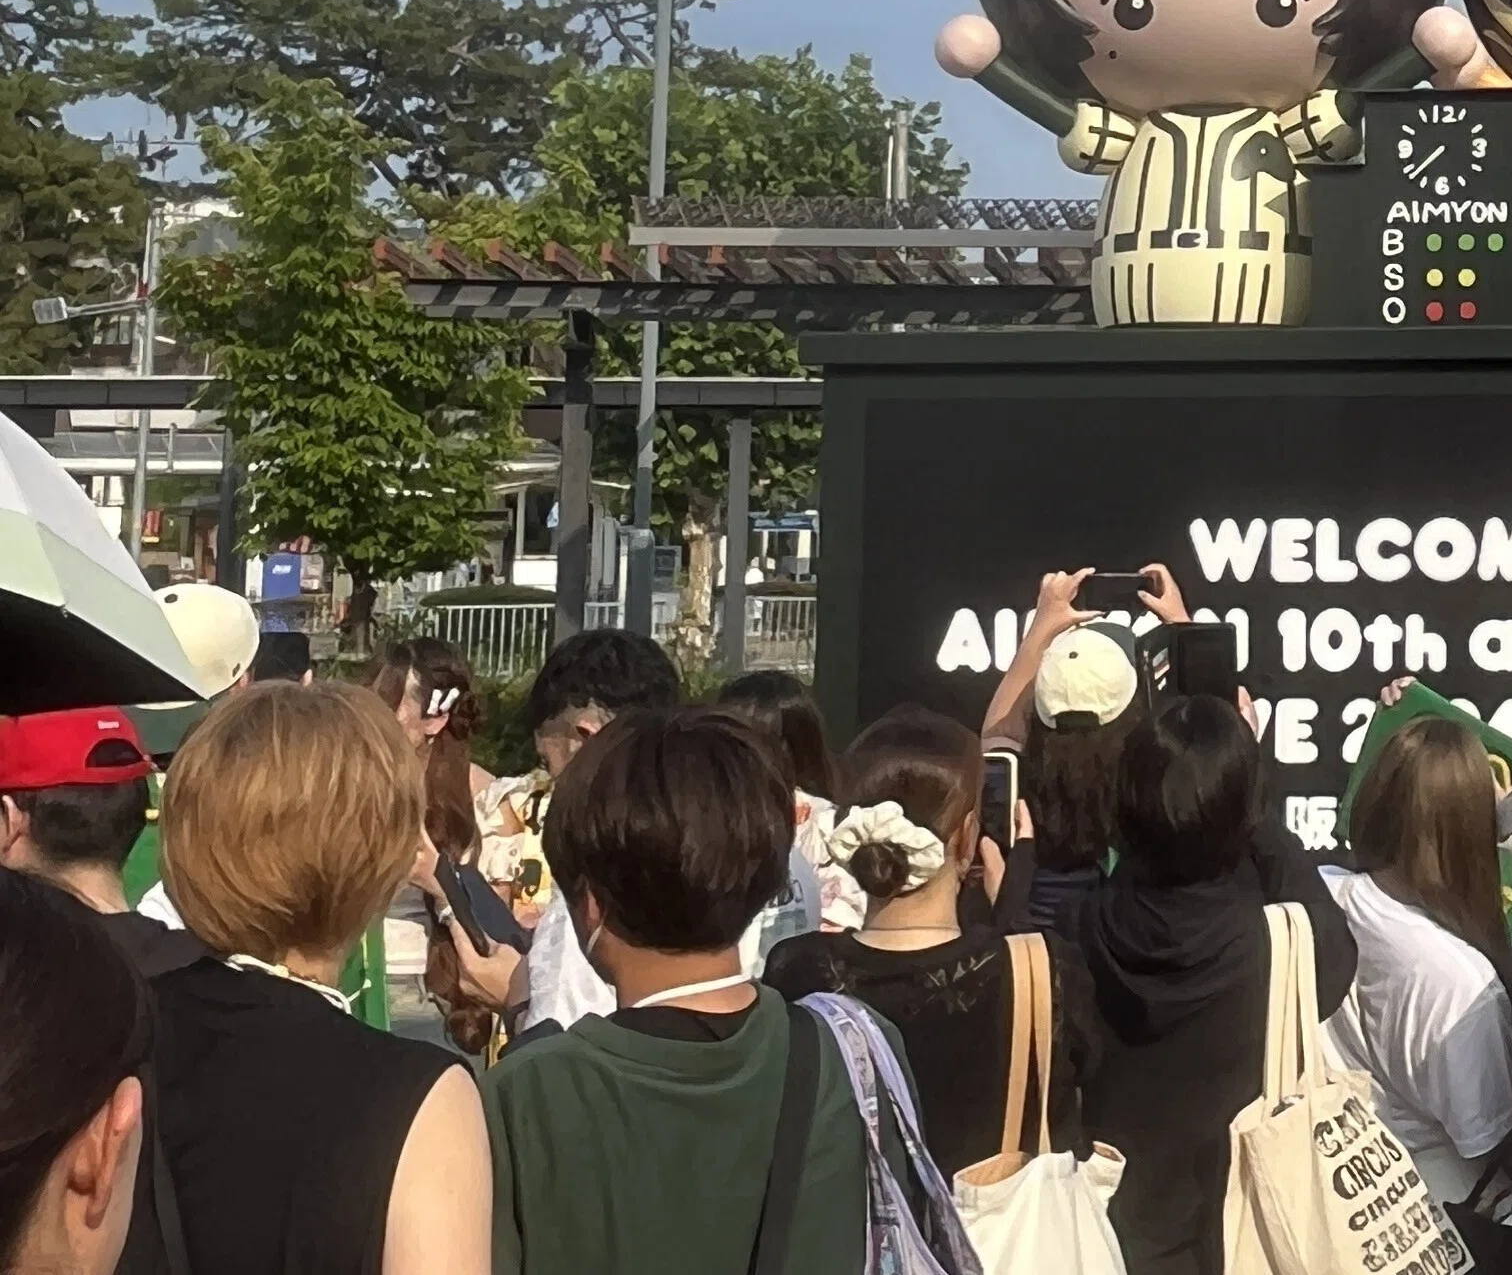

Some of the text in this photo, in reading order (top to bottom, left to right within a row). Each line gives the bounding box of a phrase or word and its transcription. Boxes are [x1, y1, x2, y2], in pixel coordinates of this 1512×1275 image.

[1432, 104, 1457, 123] 12
[1398, 139, 1413, 158] 9
[1472, 137, 1487, 158] 3
[1434, 176, 1450, 195] 6
[1386, 201, 1508, 224] AIMYON
[1382, 229, 1404, 256] B
[1384, 263, 1404, 291] S
[1382, 297, 1406, 324] O
[1277, 607, 1448, 673] 10th
